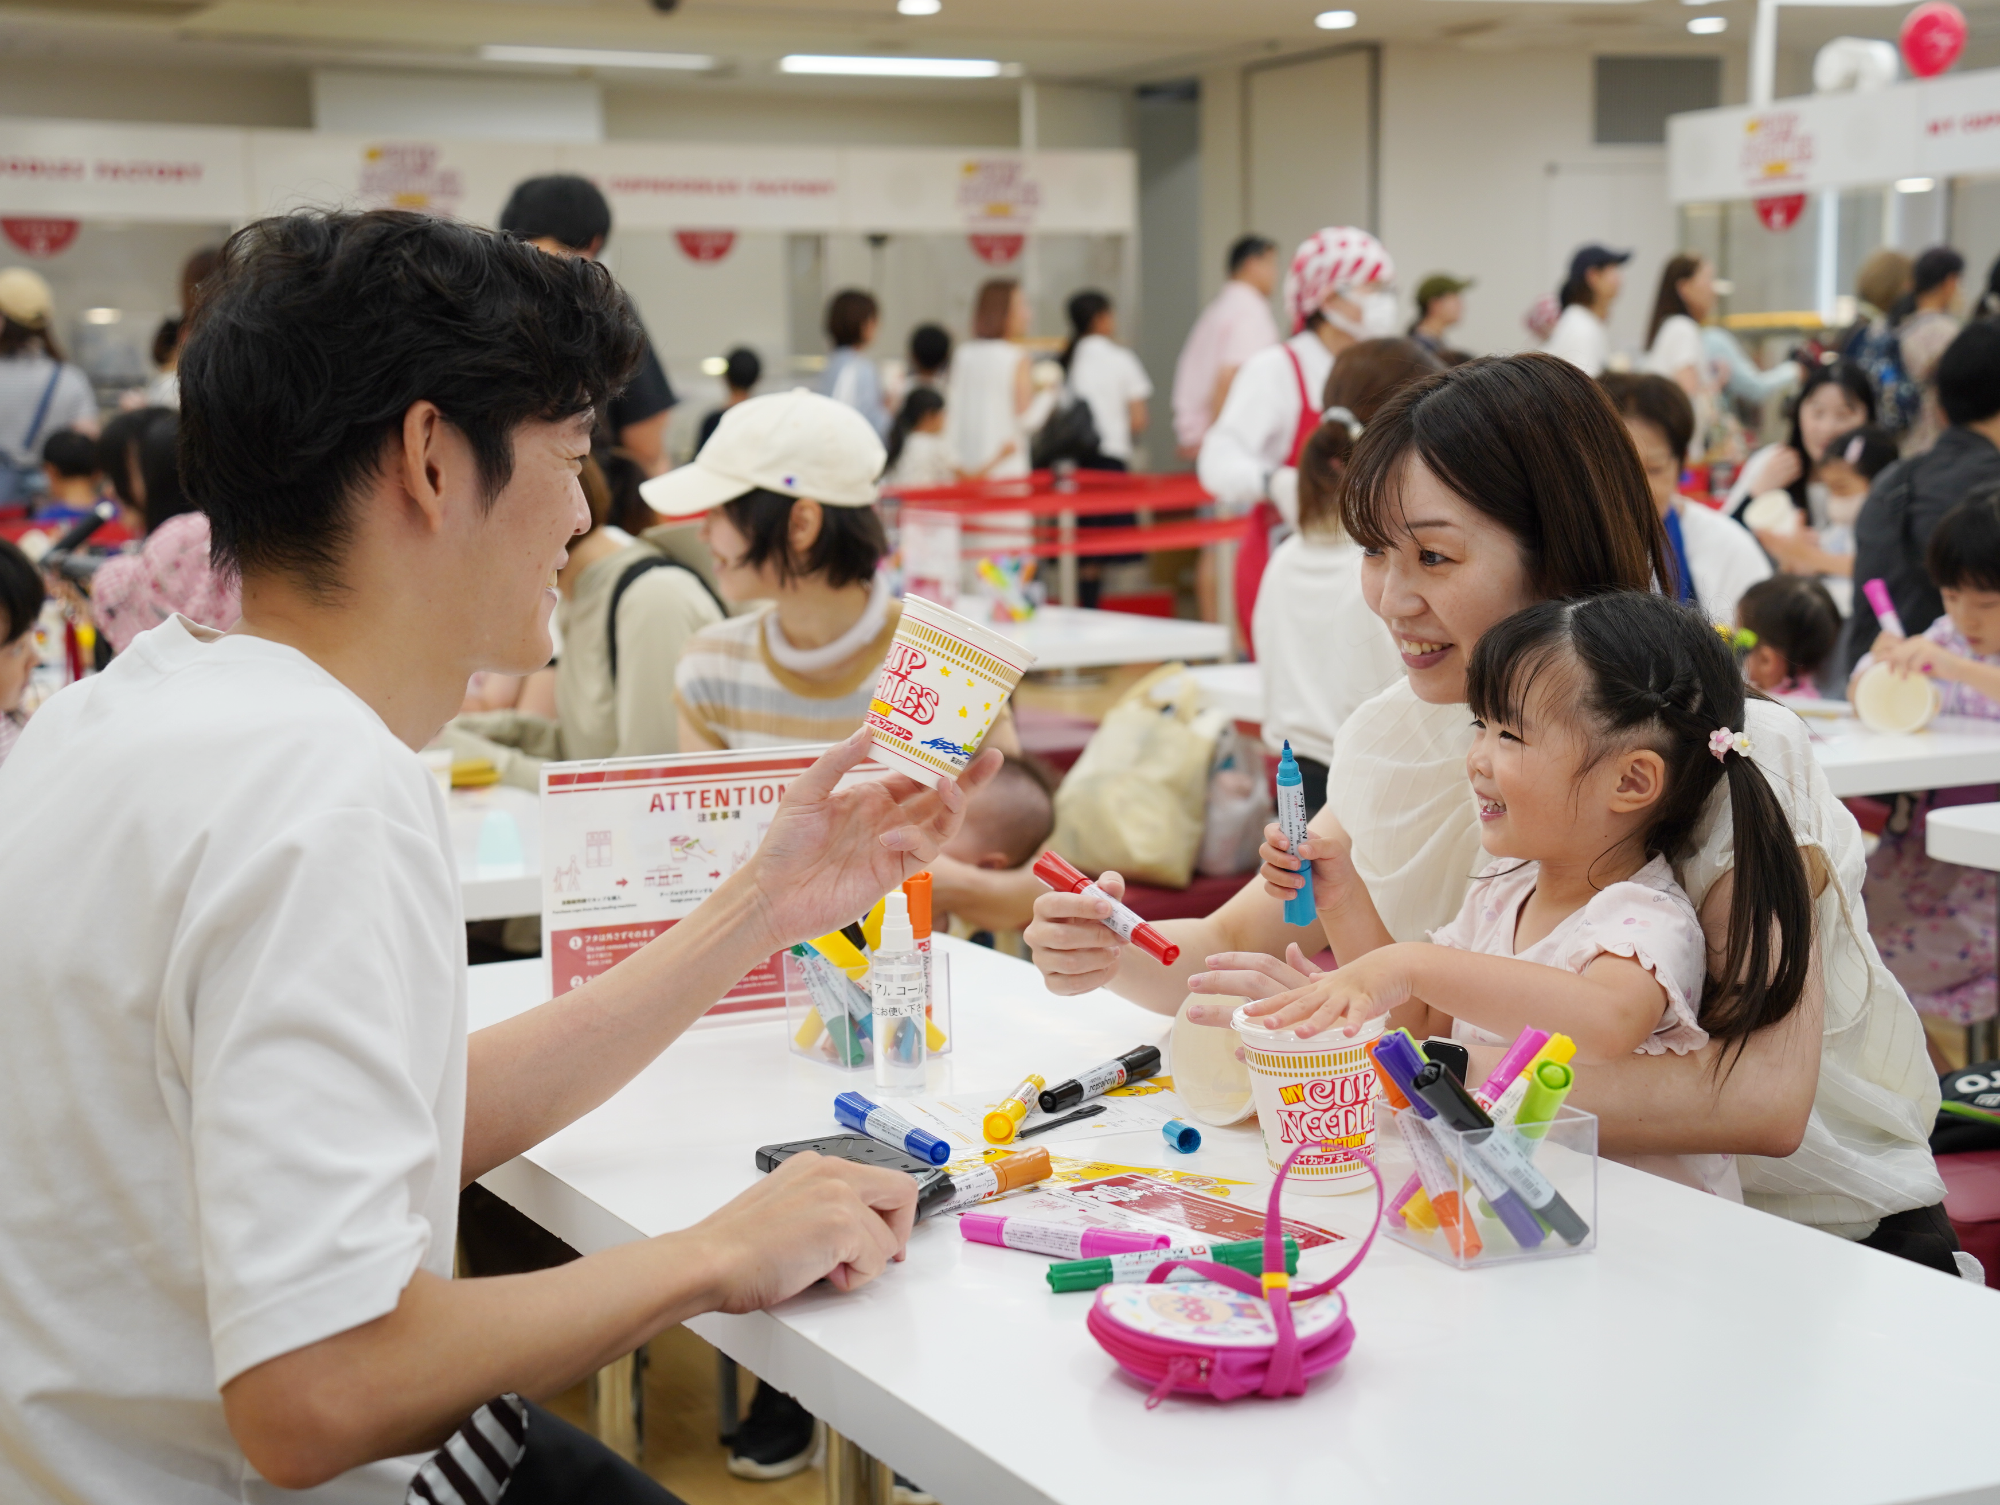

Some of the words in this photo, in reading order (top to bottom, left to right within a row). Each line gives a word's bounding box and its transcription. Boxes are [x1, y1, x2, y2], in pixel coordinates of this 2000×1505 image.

[697, 810, 741, 823] 注意事項
[1278, 1083, 1306, 1106] MY
[1302, 1068, 1377, 1112] CUP
[1320, 1132, 1366, 1153] FACTORY
